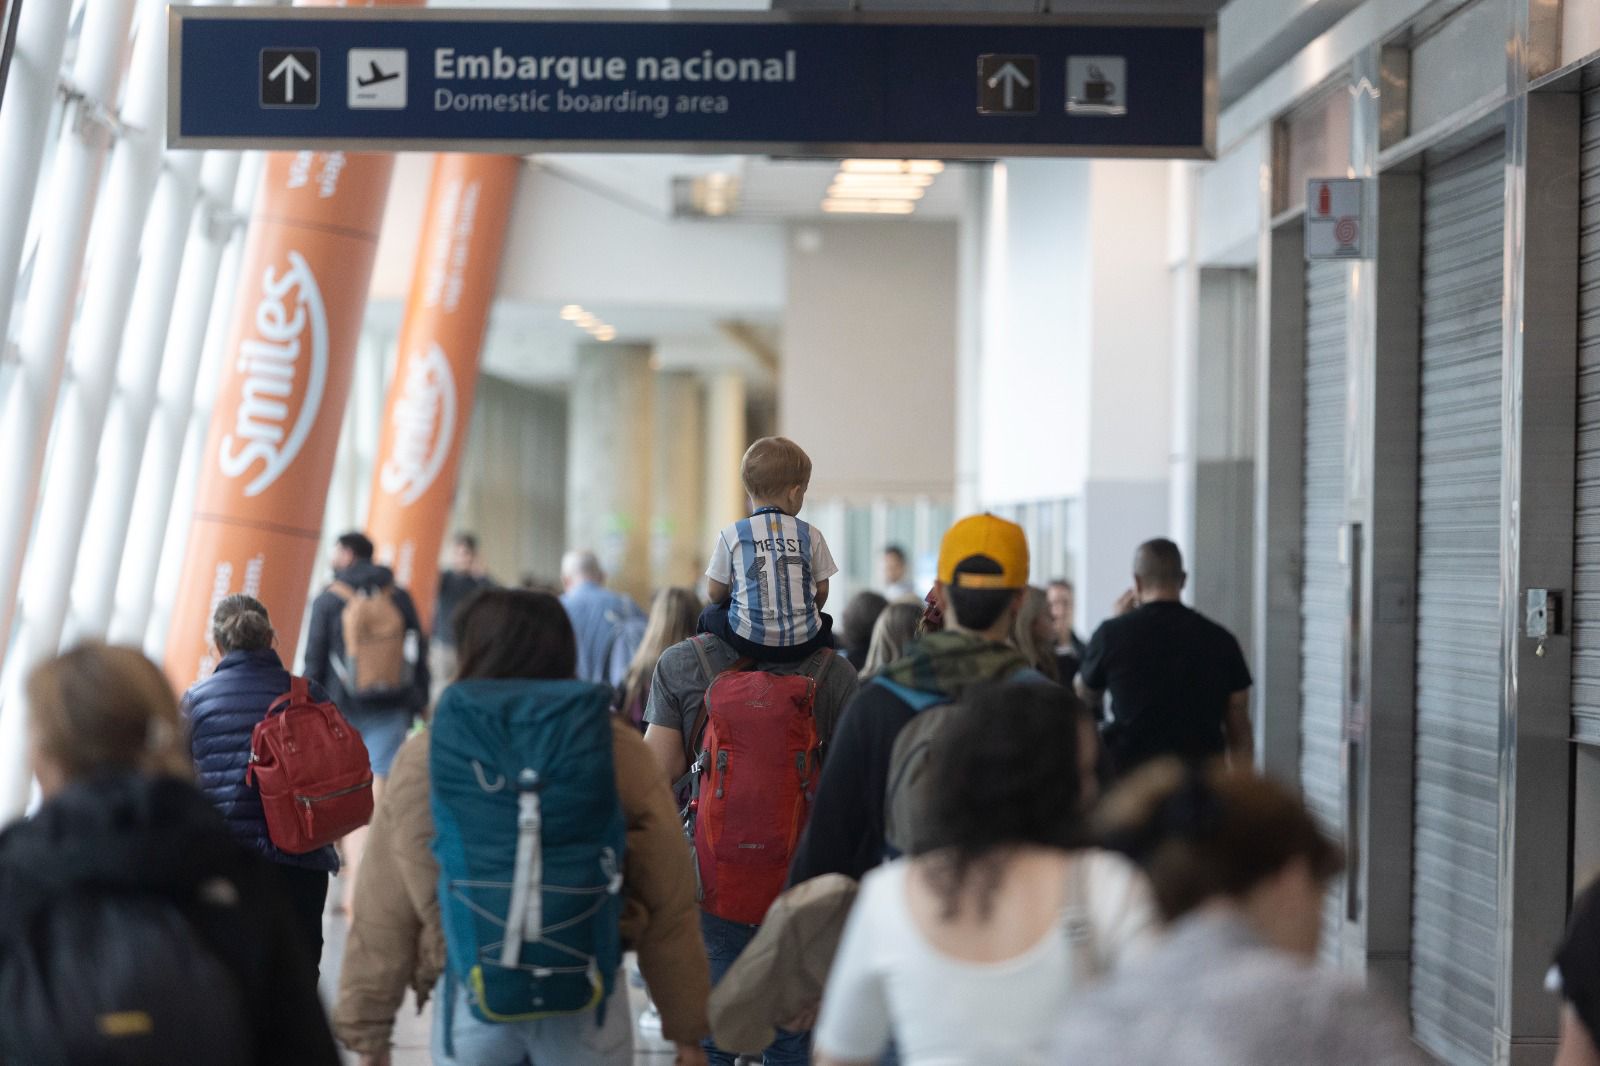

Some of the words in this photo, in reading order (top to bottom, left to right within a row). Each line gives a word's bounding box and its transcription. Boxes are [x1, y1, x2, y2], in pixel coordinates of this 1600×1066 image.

[434, 47, 627, 88] Embarque
[636, 50, 797, 82] nacional
[434, 88, 551, 113] Domestic
[557, 89, 670, 119] boarding
[675, 95, 730, 114] area
[219, 250, 330, 497] Smiles
[752, 538, 803, 554] MESSI
[746, 555, 814, 621] 10
